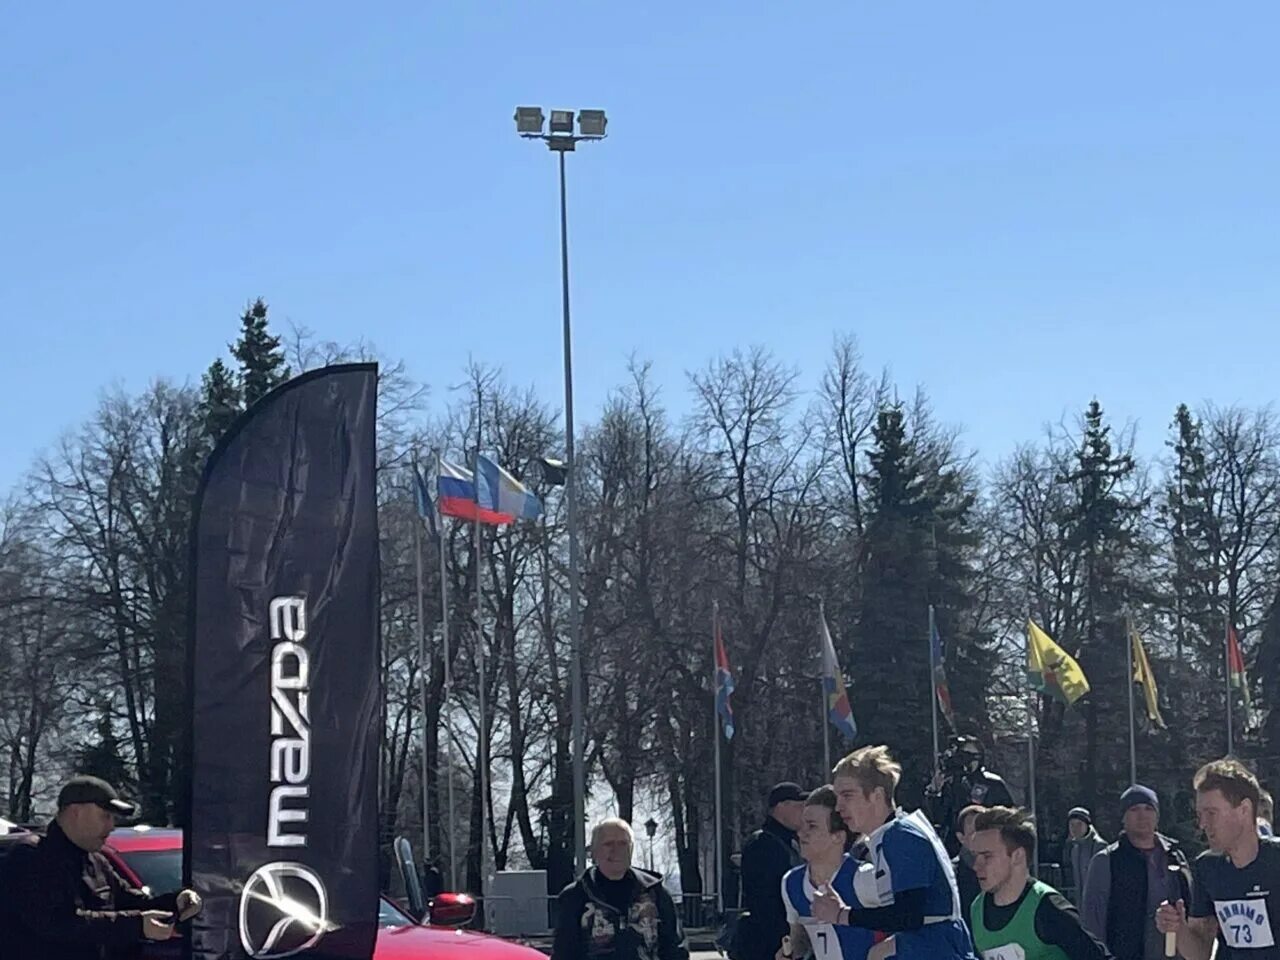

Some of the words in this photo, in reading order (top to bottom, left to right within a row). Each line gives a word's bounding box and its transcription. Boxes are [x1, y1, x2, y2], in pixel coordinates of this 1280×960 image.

[267, 594, 310, 847] mazda
[816, 932, 828, 954] 7
[1230, 924, 1253, 944] 73
